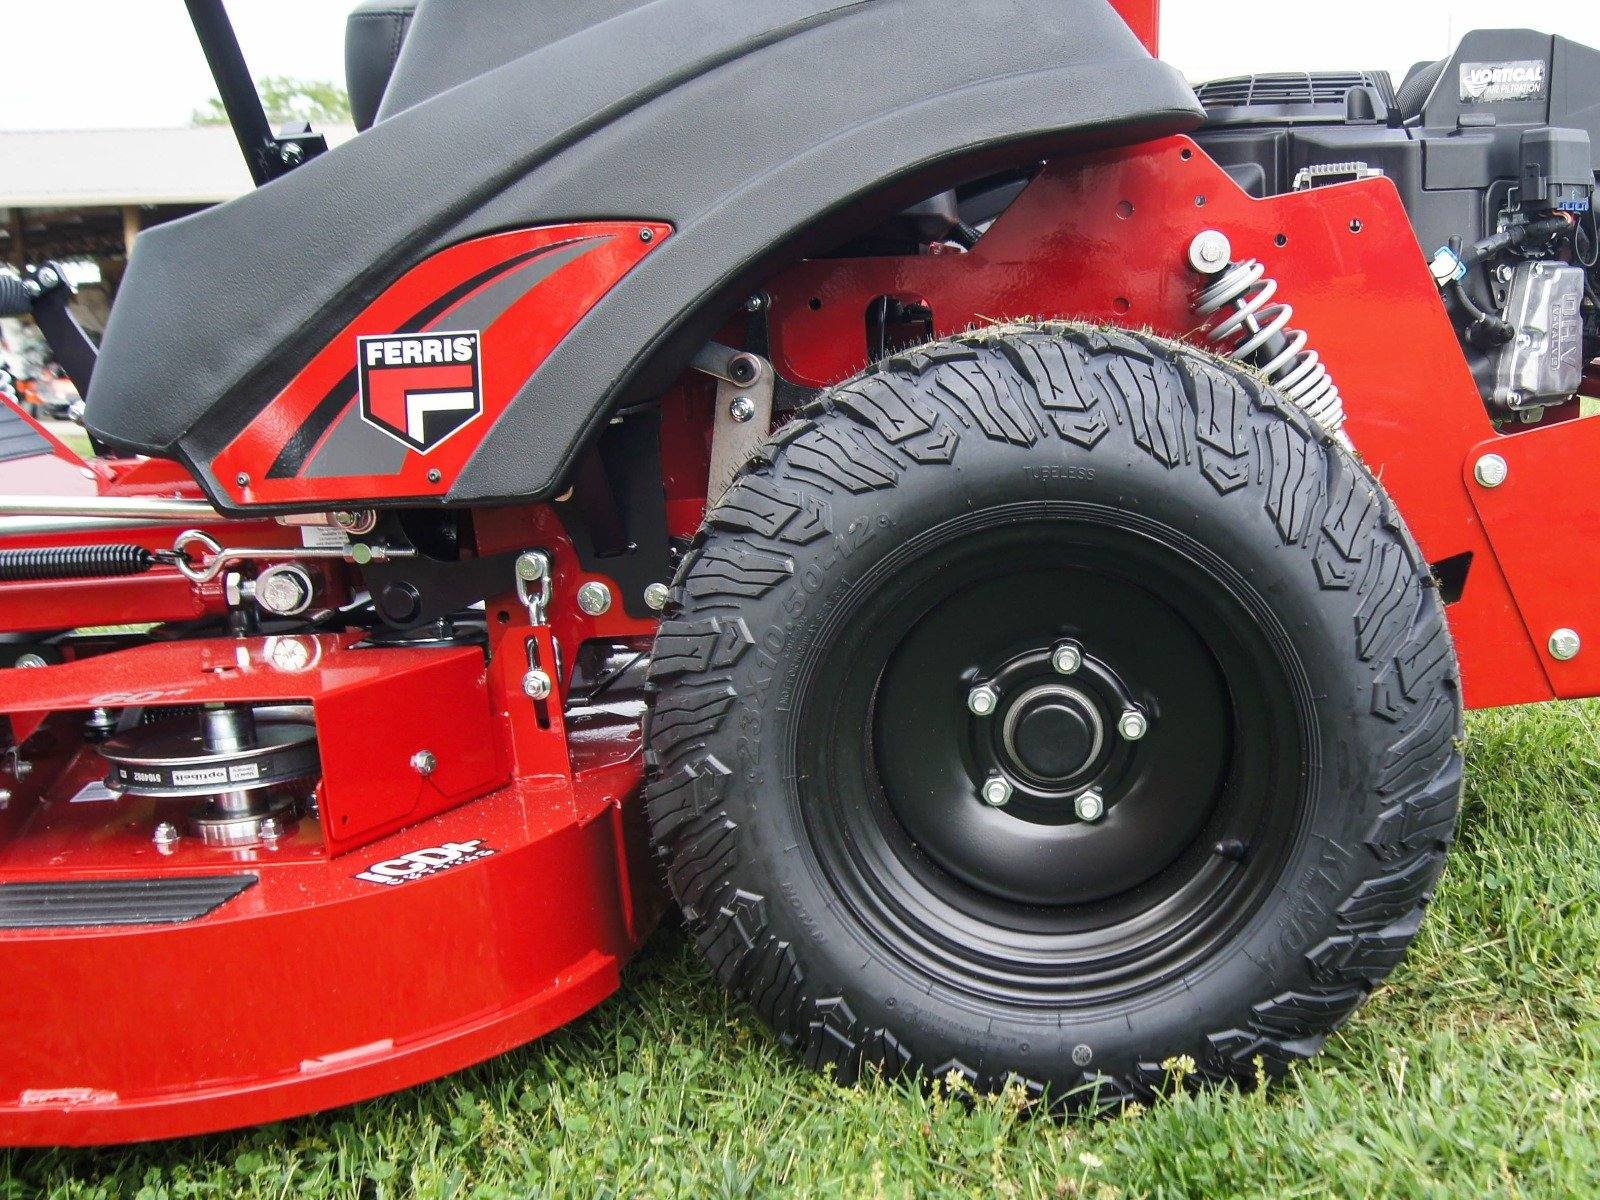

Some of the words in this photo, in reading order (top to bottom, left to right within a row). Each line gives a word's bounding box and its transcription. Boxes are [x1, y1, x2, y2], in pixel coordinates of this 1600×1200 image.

[1561, 294, 1577, 368] OHV
[366, 337, 473, 366] FERRIS
[1023, 465, 1096, 480] TUBELESS
